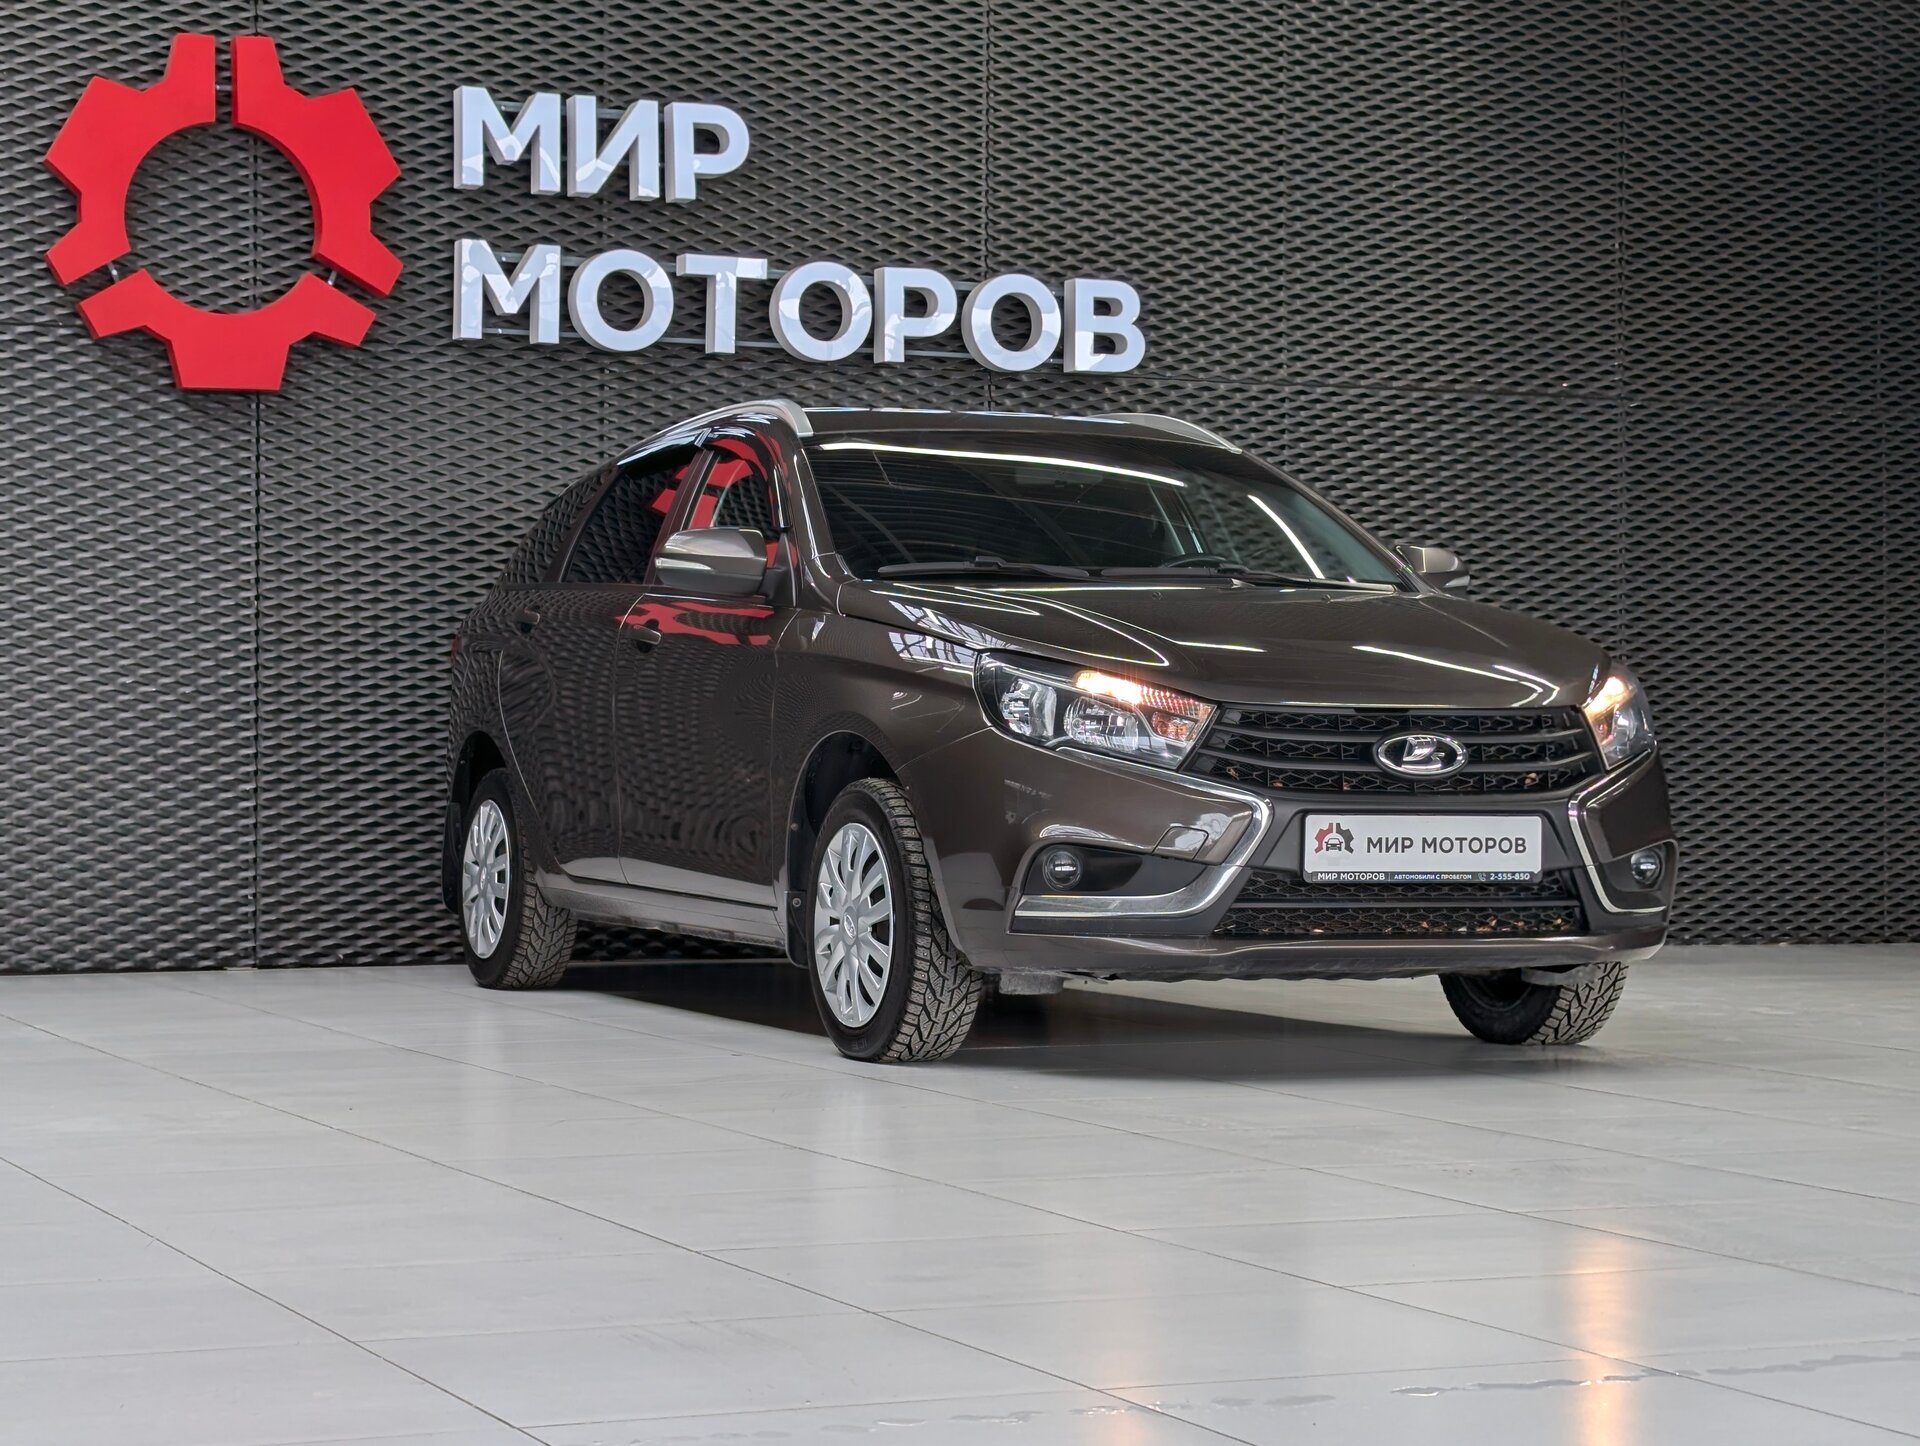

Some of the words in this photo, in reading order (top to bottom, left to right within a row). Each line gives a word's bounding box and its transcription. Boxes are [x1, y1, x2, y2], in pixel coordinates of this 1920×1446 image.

[453, 85, 750, 203] МИР
[452, 238, 1146, 373] МОТОРОВ
[1317, 872, 1338, 881] МИР
[1340, 872, 1385, 881] МОТОРОВ
[1366, 837, 1413, 854] МИР
[1421, 836, 1527, 854] МОТОРОВ
